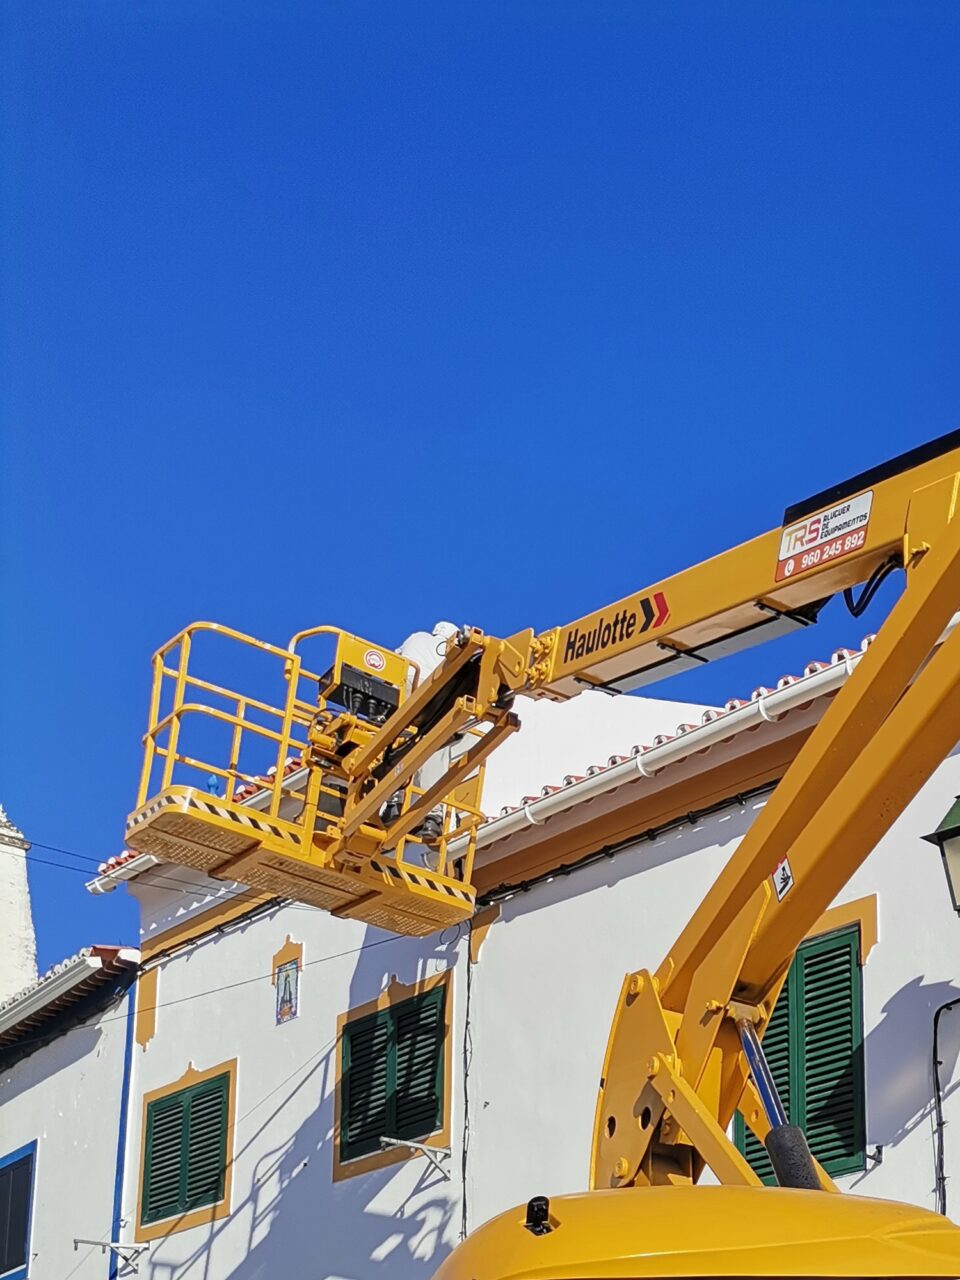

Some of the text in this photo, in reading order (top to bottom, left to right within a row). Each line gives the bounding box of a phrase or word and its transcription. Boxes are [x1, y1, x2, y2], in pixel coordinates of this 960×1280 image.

[785, 518, 821, 553] TRS
[822, 521, 830, 531] DE
[801, 530, 865, 569] 960 245 892
[562, 609, 637, 664] Haulotte
